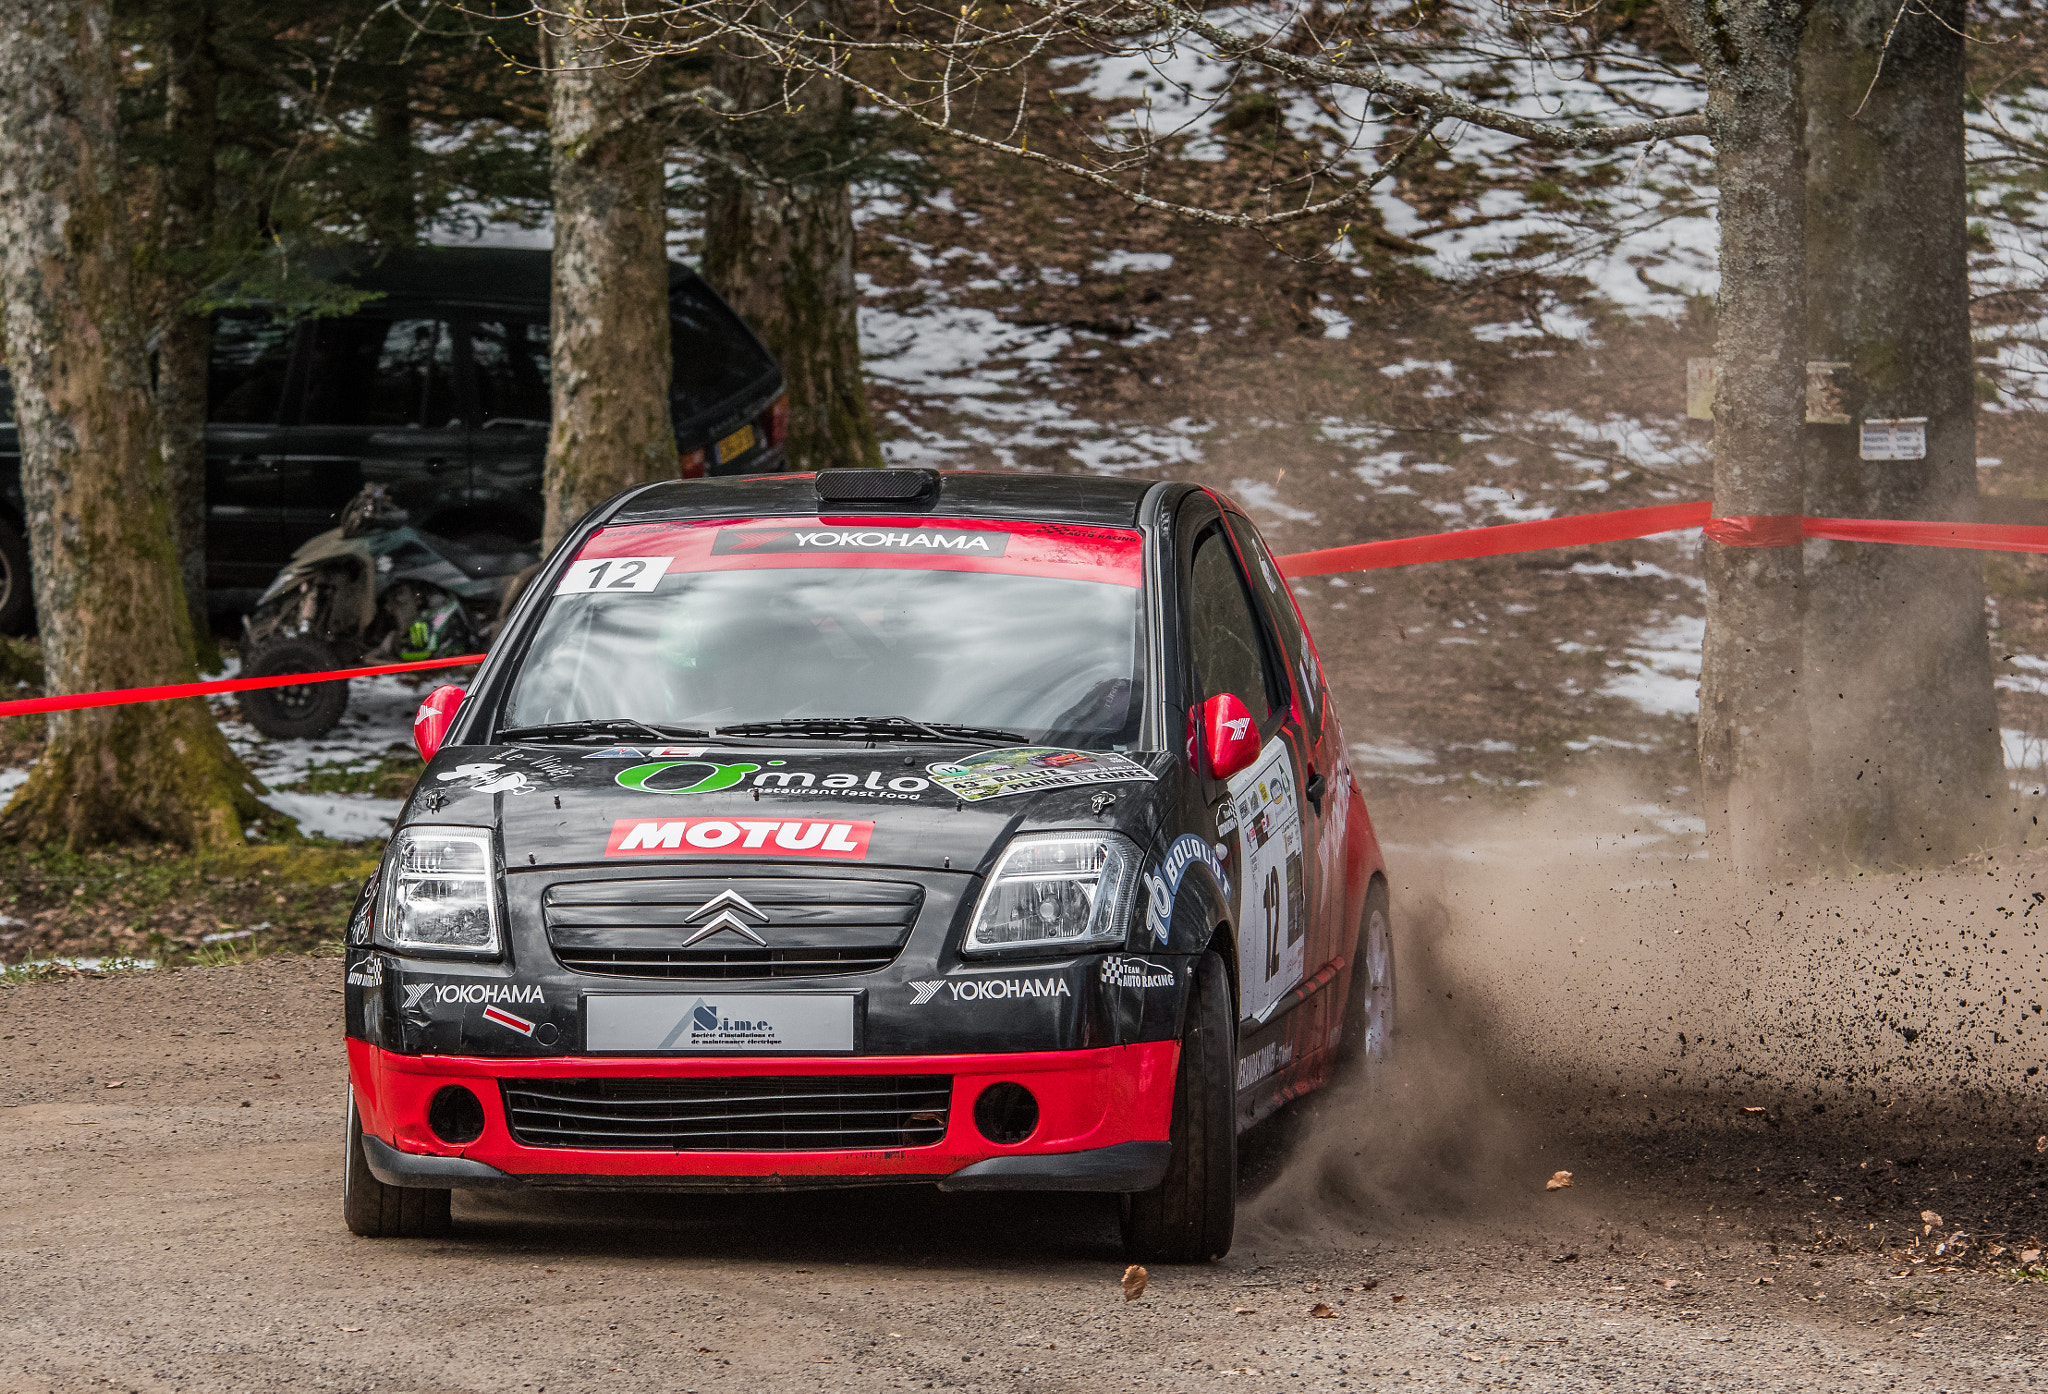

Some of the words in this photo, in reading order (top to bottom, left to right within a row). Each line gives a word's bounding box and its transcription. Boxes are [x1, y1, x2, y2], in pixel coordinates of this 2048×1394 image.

[794, 532, 990, 551] YOKOHAMA
[588, 560, 647, 589] 12
[941, 766, 963, 774] 12
[992, 768, 1062, 783] RALLYE
[1007, 776, 1075, 791] PLAINE
[1093, 769, 1150, 779] CIMES
[746, 787, 838, 796] restaurant
[841, 788, 876, 798] fast
[879, 790, 921, 801] food
[617, 821, 859, 852] MOTUL
[1164, 838, 1231, 896] BOUQUOT
[1263, 866, 1280, 983] 12
[948, 977, 1071, 1001] YOKOHAMA
[1122, 974, 1141, 987] AUTO
[1141, 974, 1175, 988] RACING
[434, 984, 545, 1004] YOKOHAMA
